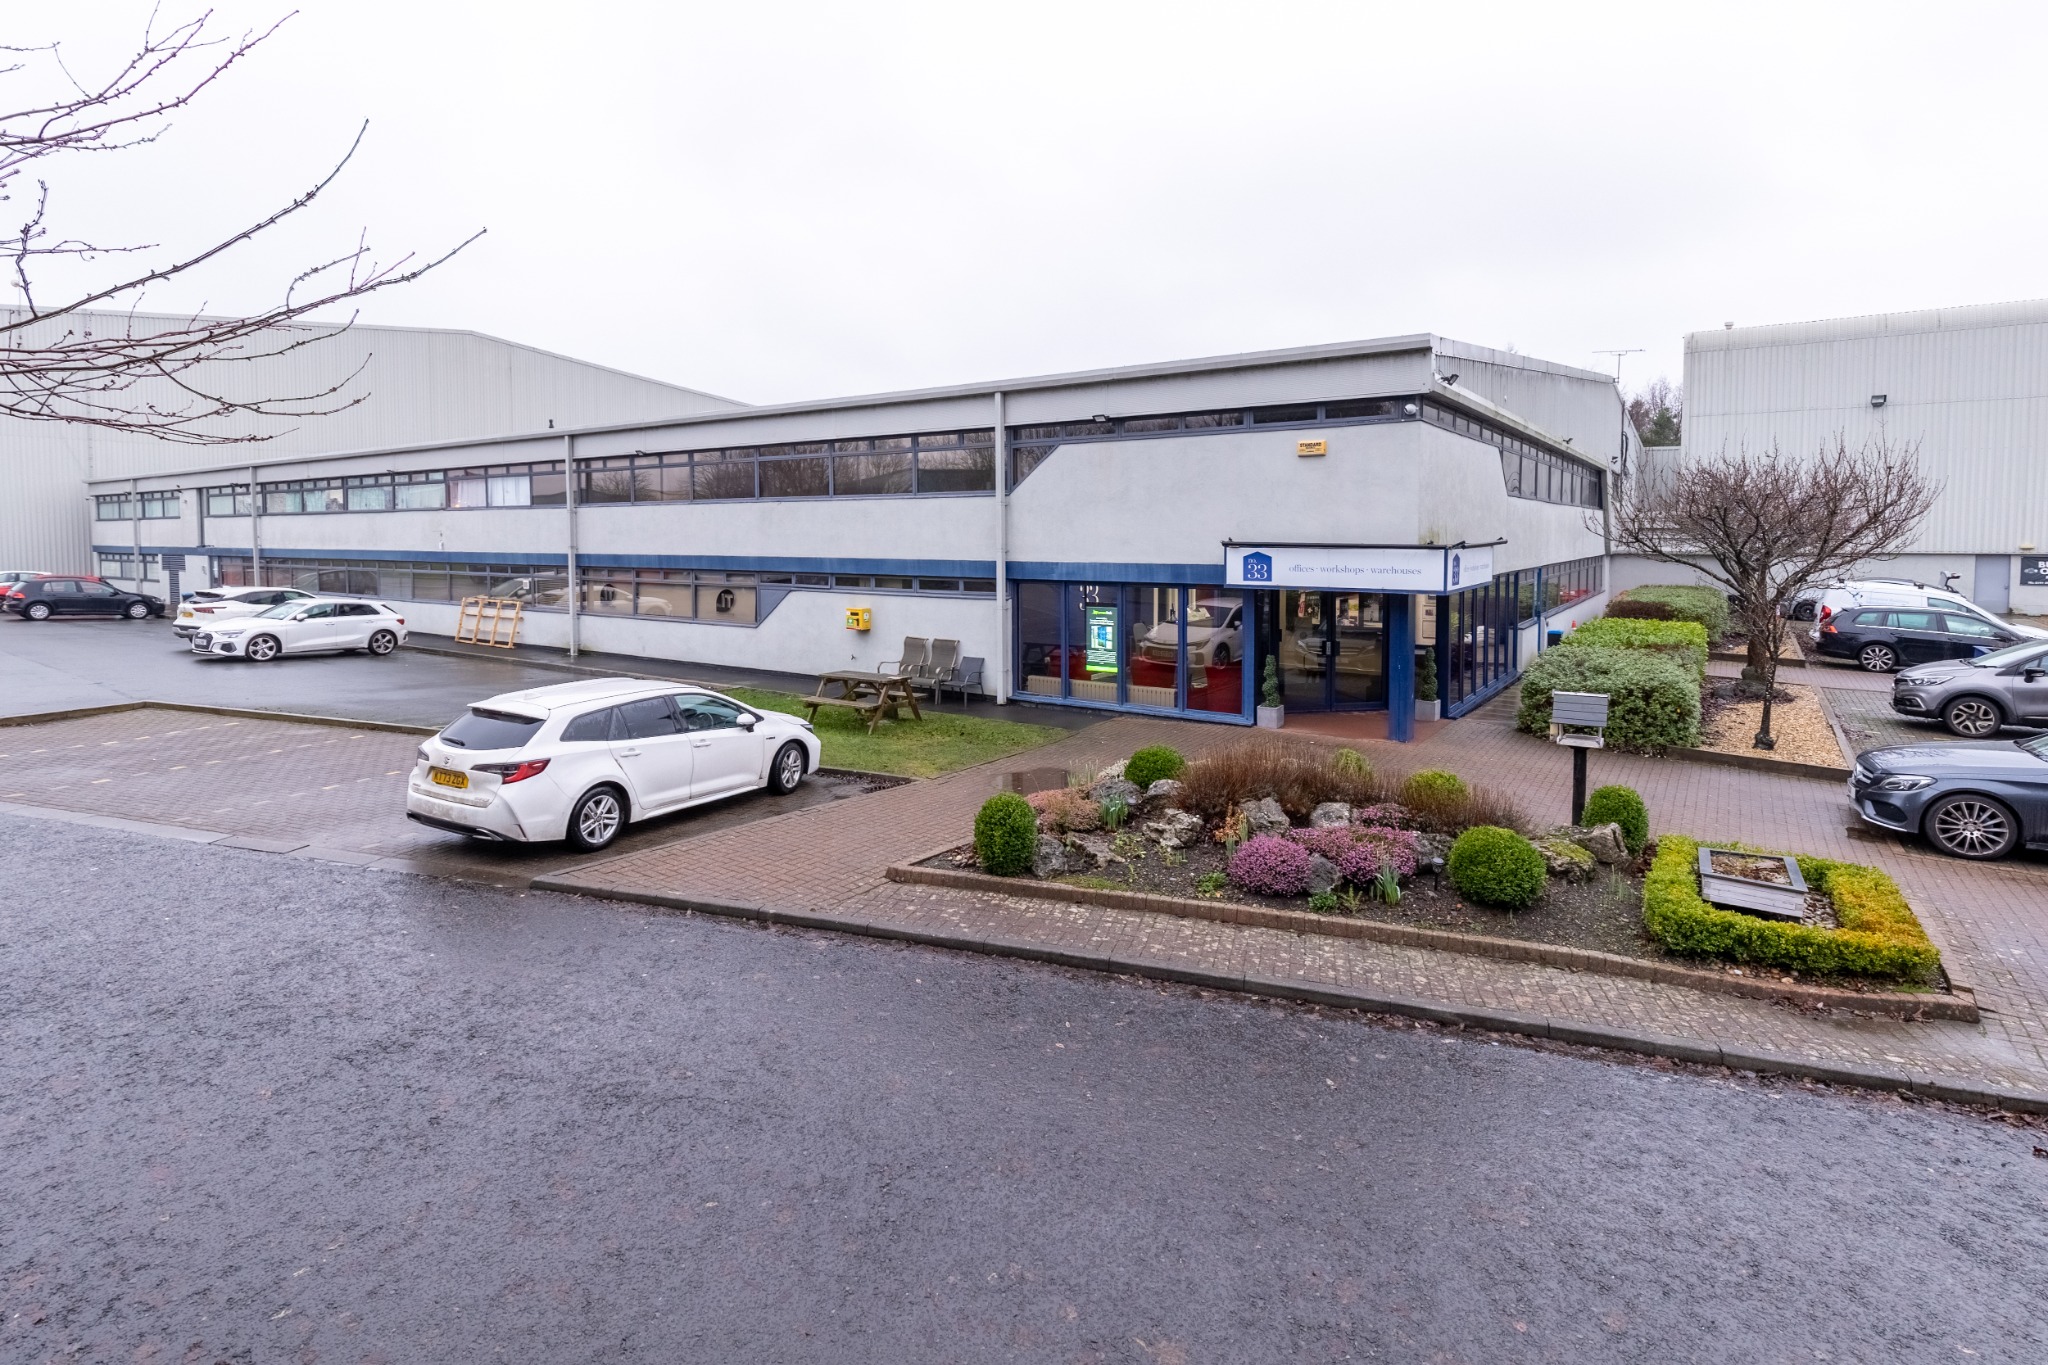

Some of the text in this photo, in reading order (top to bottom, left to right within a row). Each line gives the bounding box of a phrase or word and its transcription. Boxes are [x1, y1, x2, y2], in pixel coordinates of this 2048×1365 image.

[1247, 563, 1267, 579] 33
[1289, 564, 1422, 575] offices workshops warehouses
[433, 771, 466, 786] KT73 ZGX
